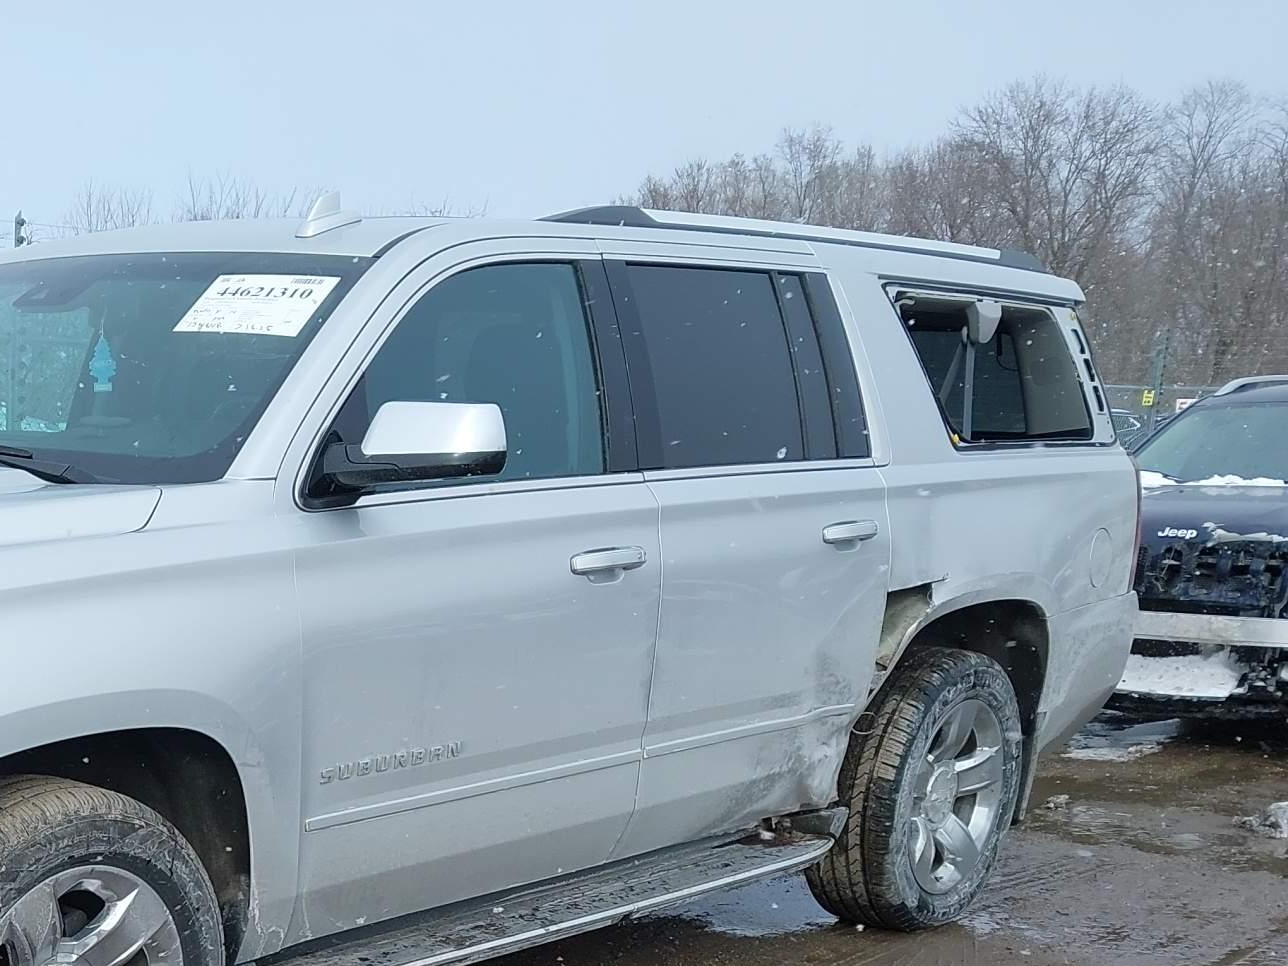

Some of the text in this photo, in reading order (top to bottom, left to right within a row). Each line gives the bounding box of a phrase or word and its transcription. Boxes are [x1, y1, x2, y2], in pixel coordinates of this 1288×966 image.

[217, 286, 313, 300] 44621310
[1157, 527, 1198, 540] Jeep
[319, 740, 462, 785] SUBURBAN
